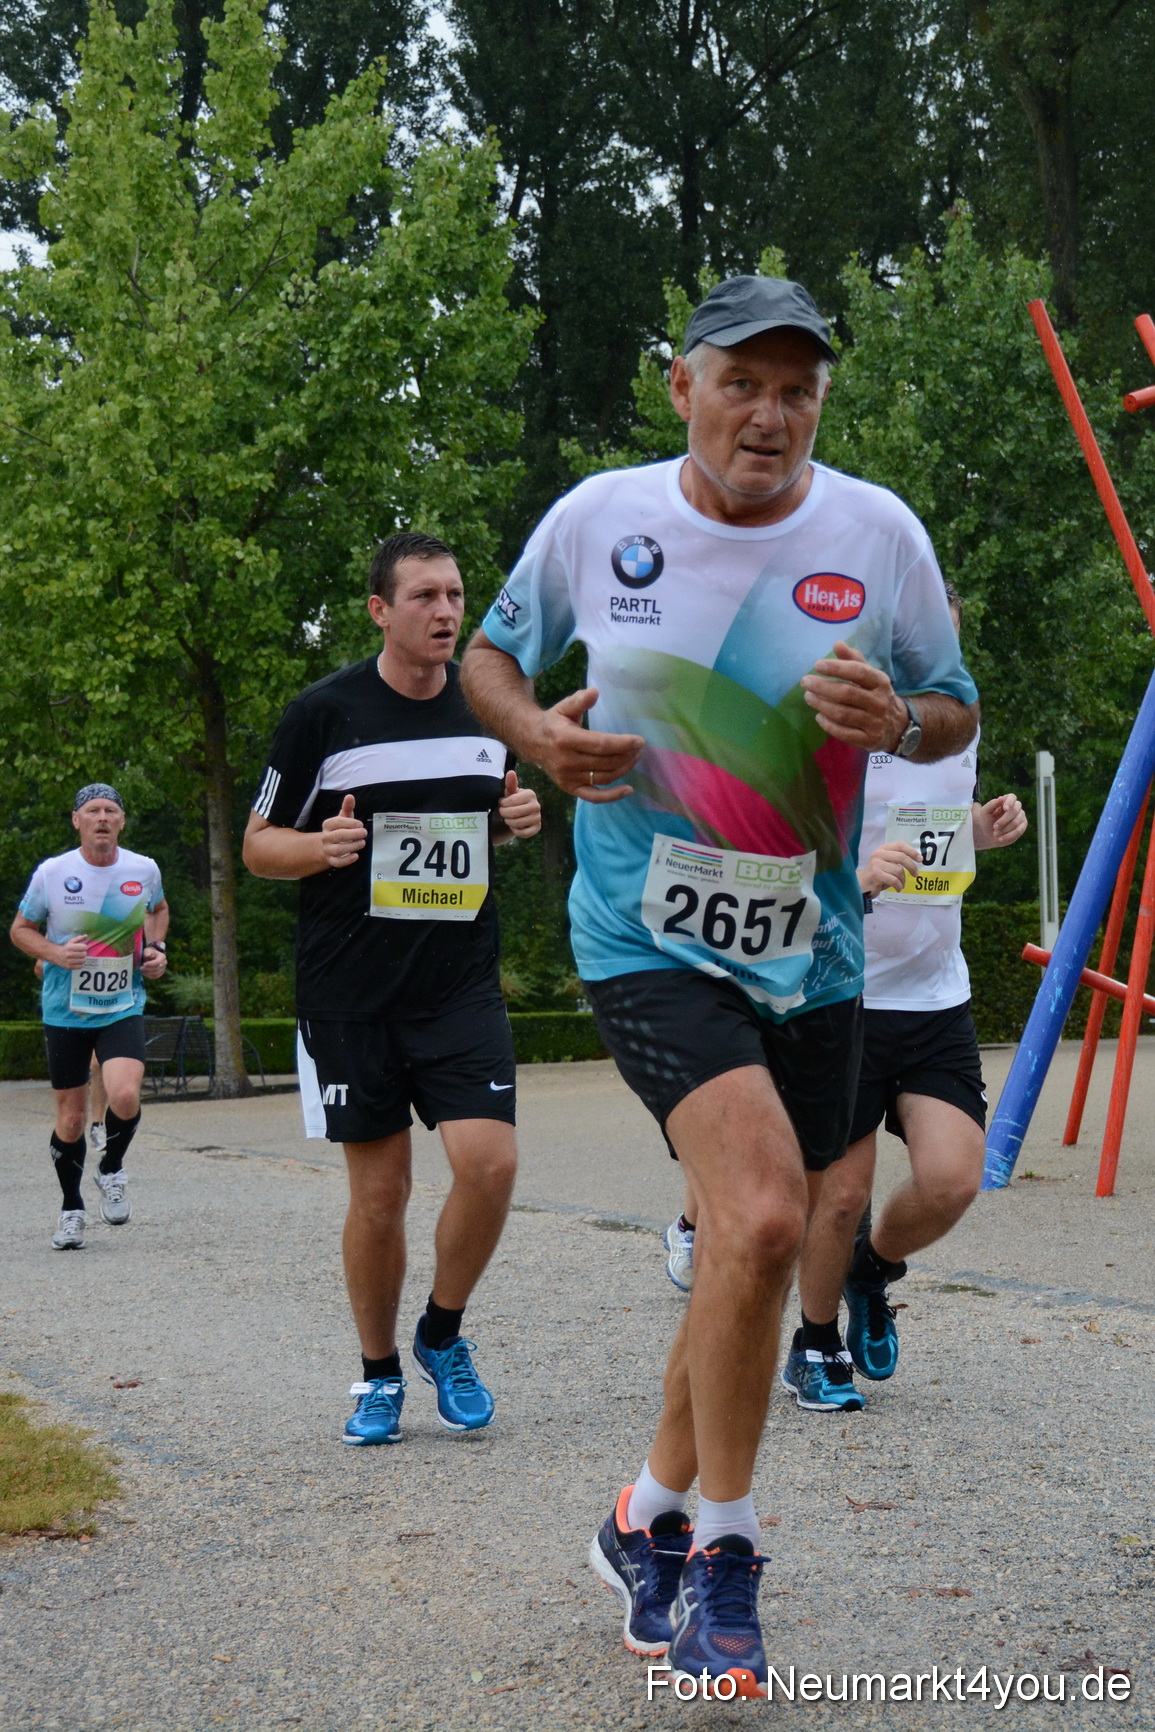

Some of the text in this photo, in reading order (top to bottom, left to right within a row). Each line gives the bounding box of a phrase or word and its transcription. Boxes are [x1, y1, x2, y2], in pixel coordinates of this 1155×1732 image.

[617, 535, 661, 555] BMW
[610, 596, 662, 614] PARTL
[804, 583, 861, 611] Hervis
[610, 612, 661, 626] Neumarkt
[384, 823, 422, 831] NeuerMarkt
[429, 816, 477, 830] BOCK
[896, 816, 927, 824] NeuerMarkt
[919, 830, 954, 866] 67
[398, 837, 470, 879] 240
[665, 857, 724, 878] NeuerMarkt
[735, 859, 803, 884] BOC
[915, 876, 949, 892] Stefan
[402, 888, 463, 905] Michael
[663, 884, 807, 956] 2651
[79, 969, 128, 992] 2028
[88, 996, 118, 1006] Thomas
